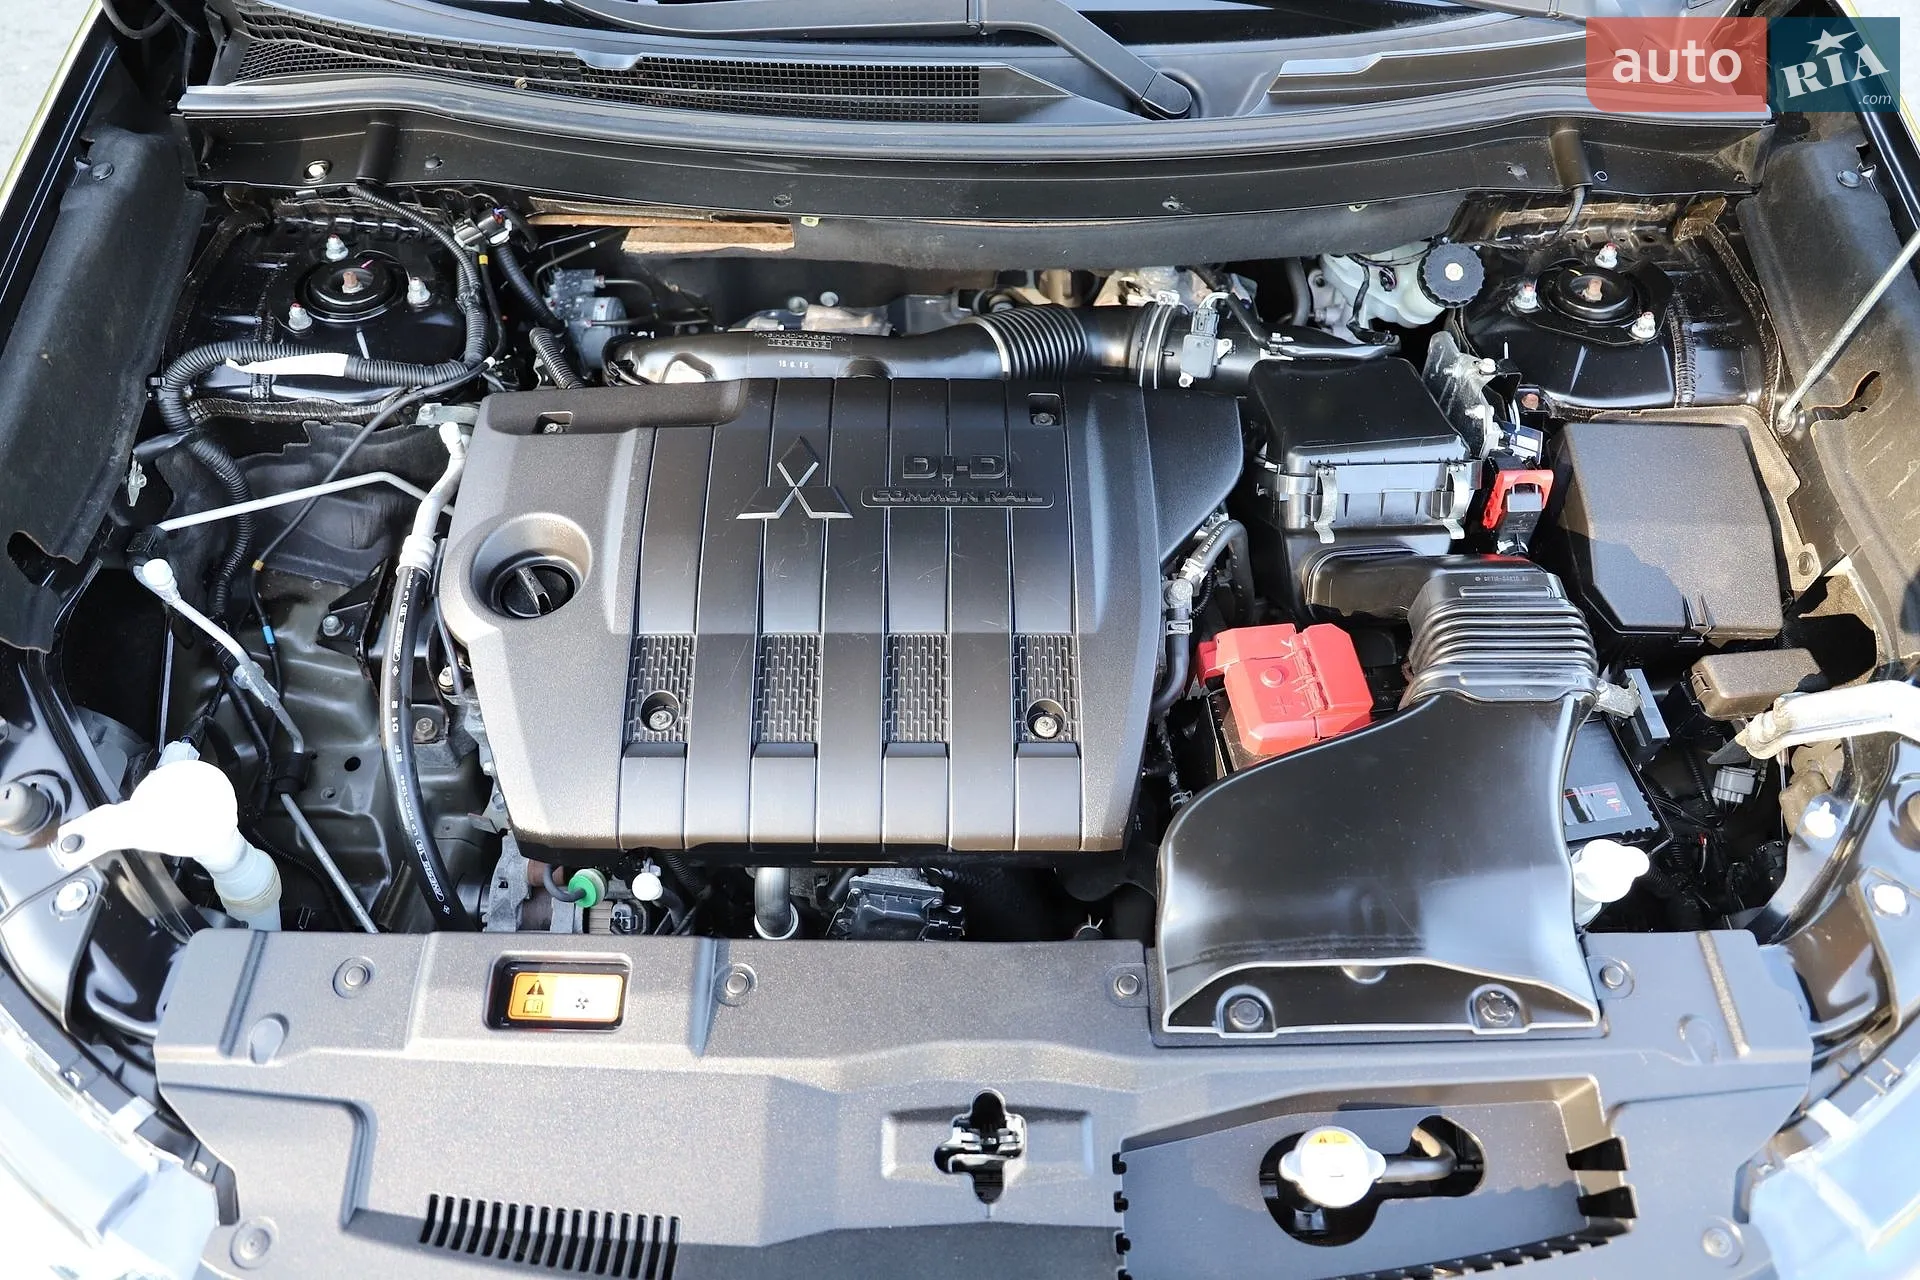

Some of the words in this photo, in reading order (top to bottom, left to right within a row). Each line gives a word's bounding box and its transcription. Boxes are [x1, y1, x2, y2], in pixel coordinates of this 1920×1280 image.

[903, 454, 1008, 480] DI-D
[872, 487, 978, 503] COMMON
[984, 487, 1043, 503] RAIL
